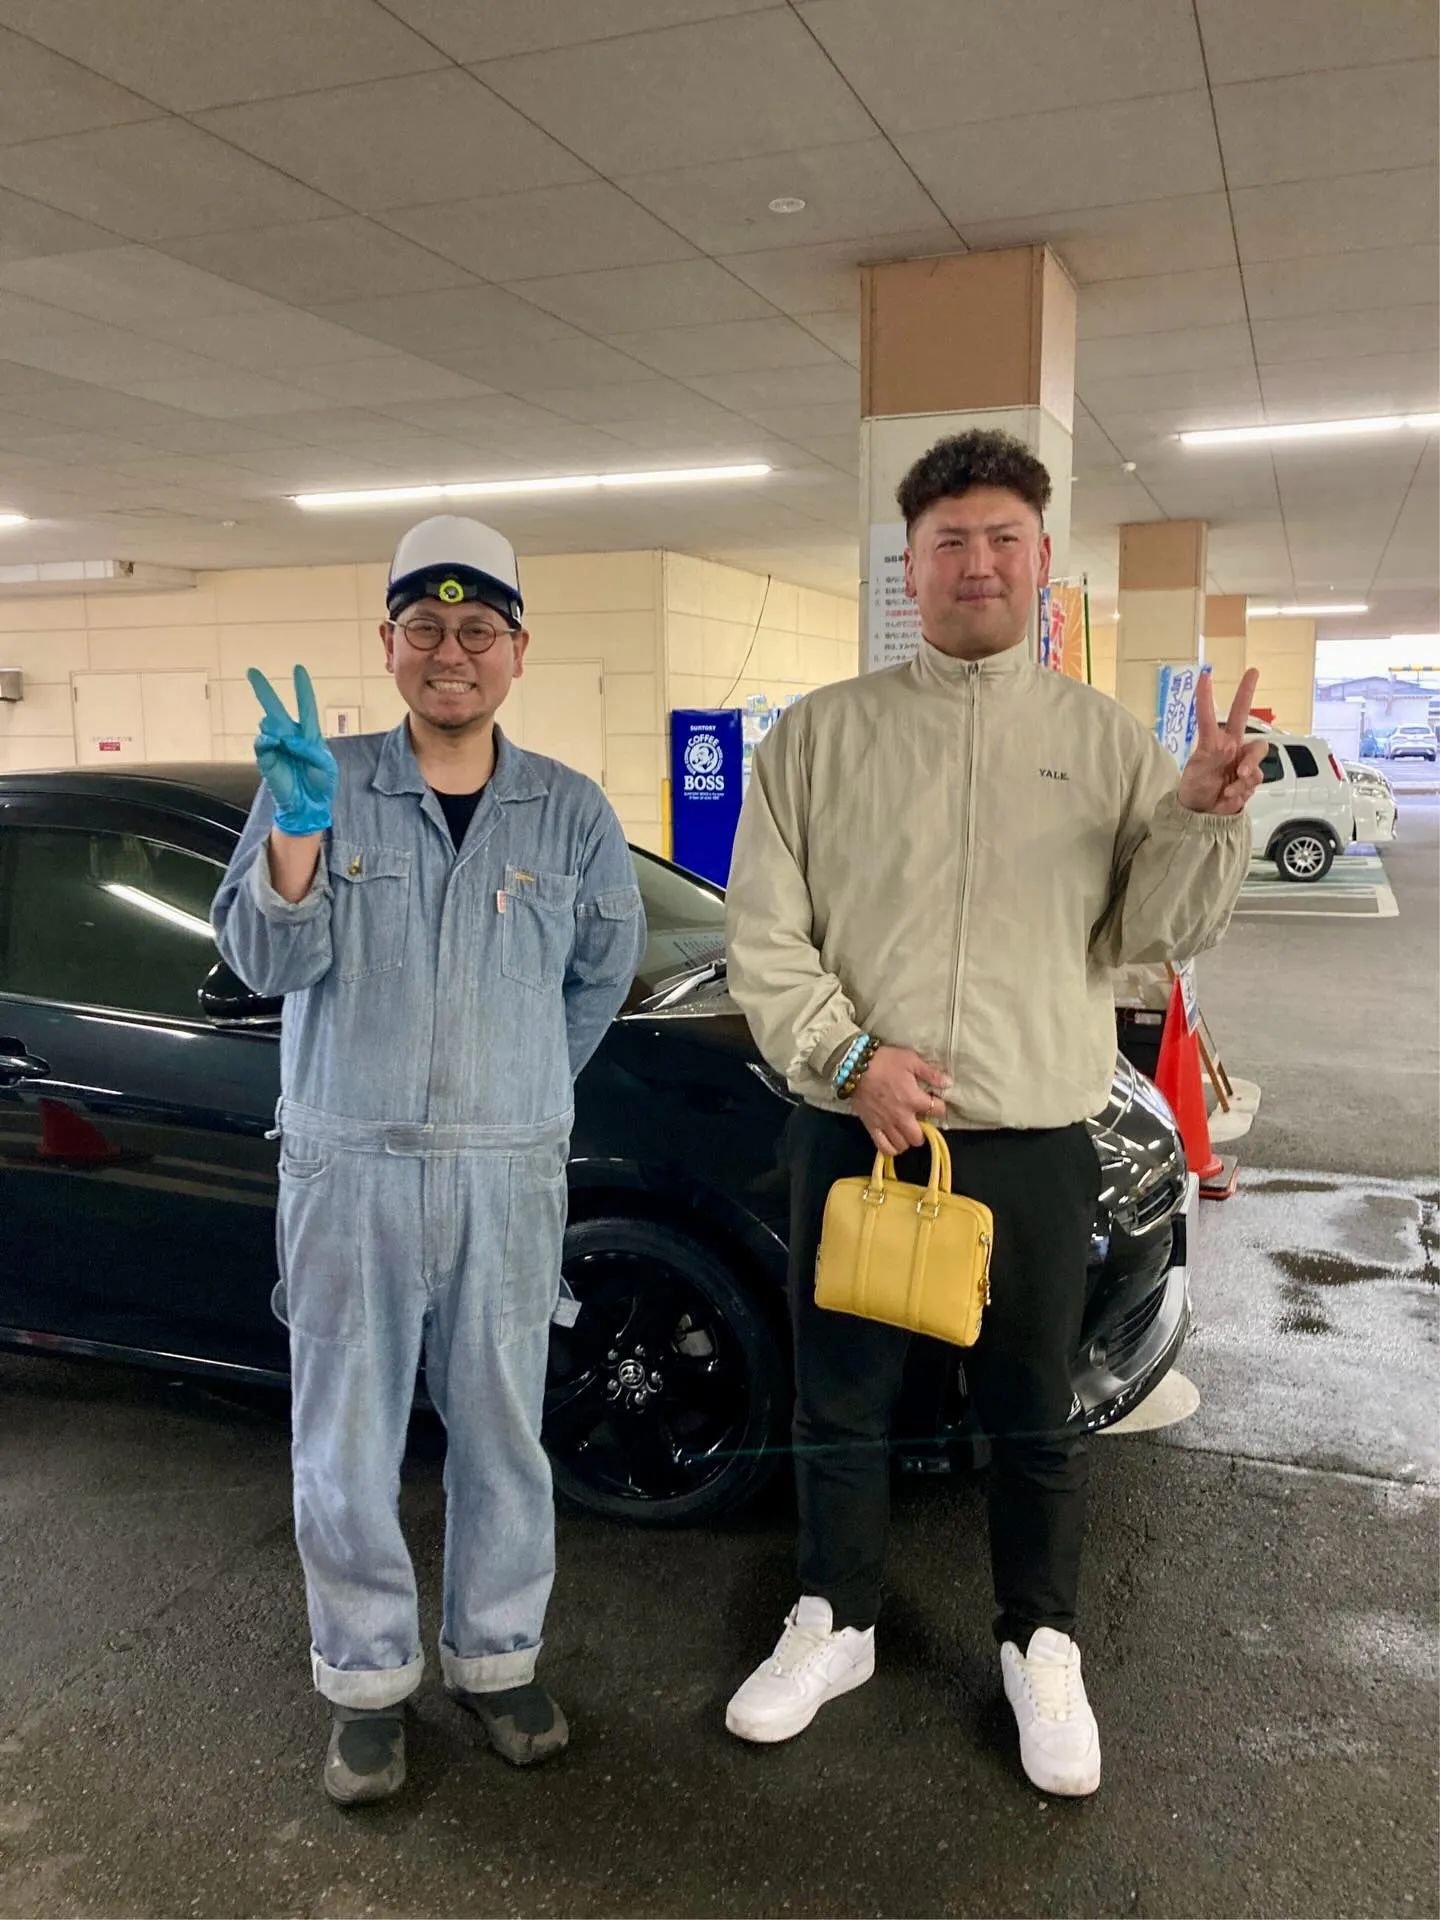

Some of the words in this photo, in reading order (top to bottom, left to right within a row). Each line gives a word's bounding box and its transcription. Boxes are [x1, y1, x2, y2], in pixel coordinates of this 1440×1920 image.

[688, 734, 719, 747] COFFEE
[1039, 768, 1069, 780] YALE
[684, 775, 724, 791] BOSS
